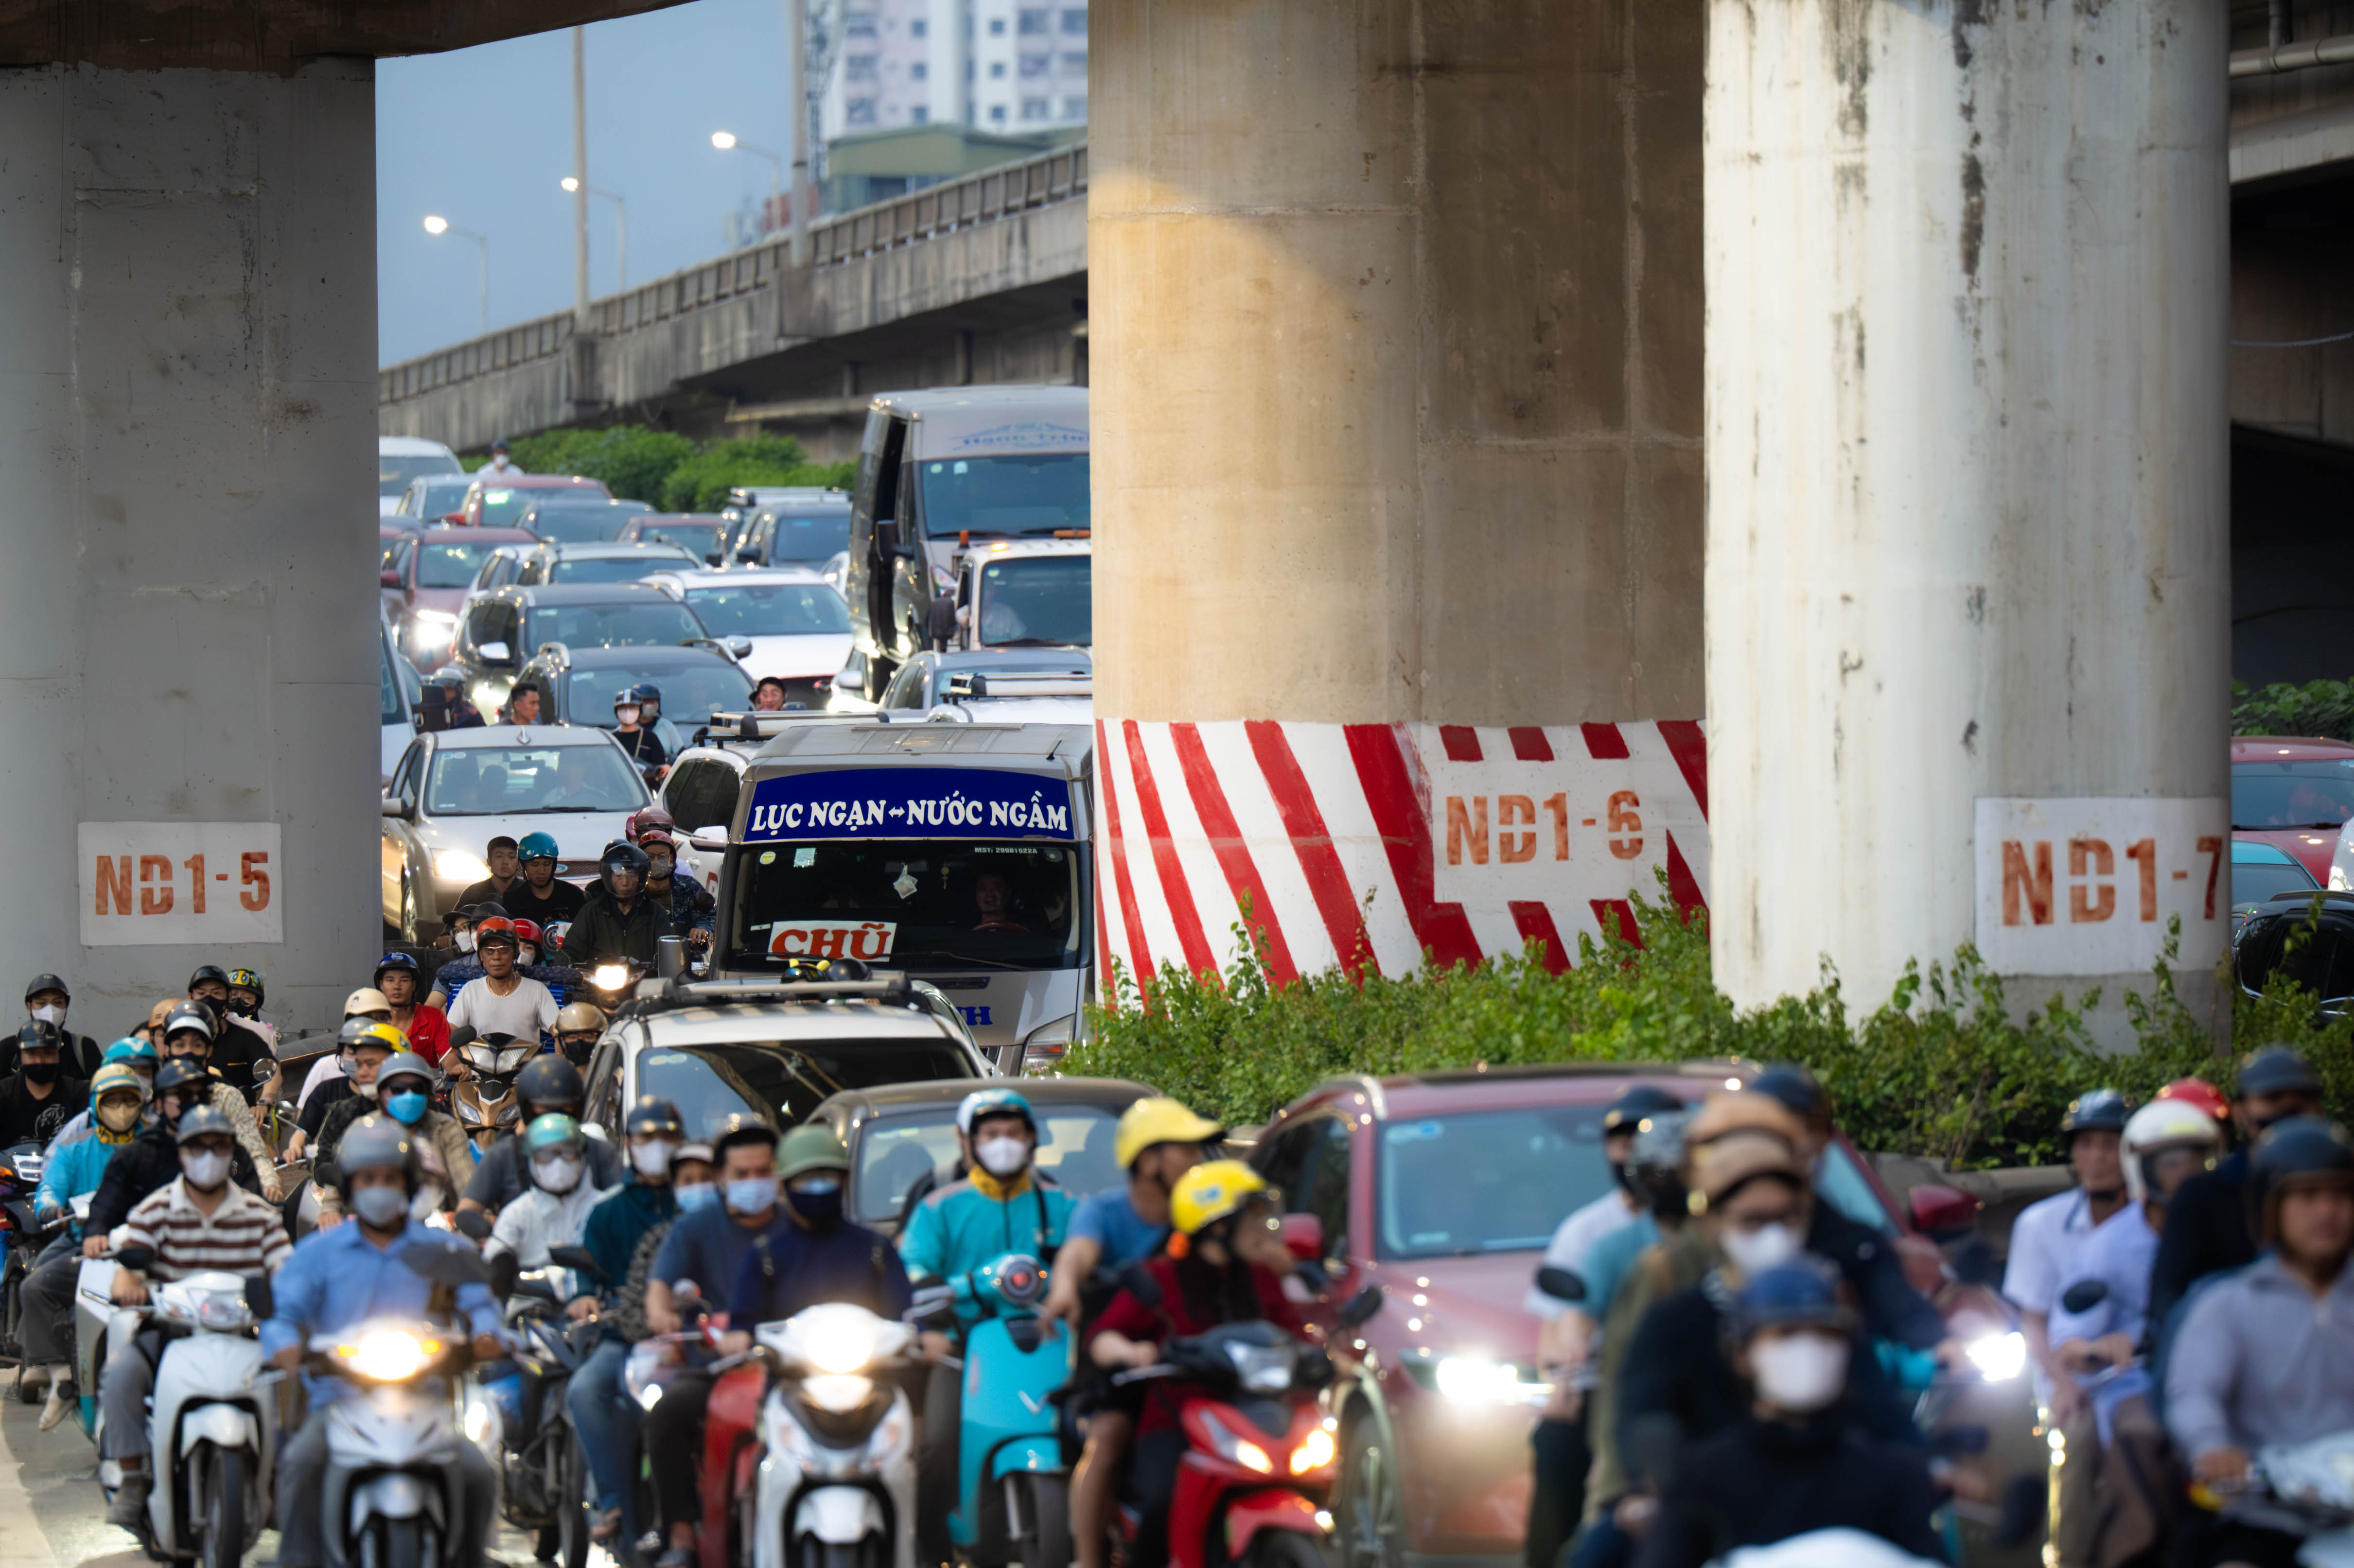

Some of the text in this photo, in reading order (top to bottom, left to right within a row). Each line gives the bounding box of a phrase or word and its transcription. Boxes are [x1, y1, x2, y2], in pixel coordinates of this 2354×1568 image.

[751, 790, 1068, 836] LỤC NGẠN NƯỚC NGẦM
[1445, 789, 1644, 866] ND1-6
[95, 851, 270, 916] ND1-5
[2002, 836, 2223, 926] ND1-7
[772, 923, 891, 960] CHŨ
